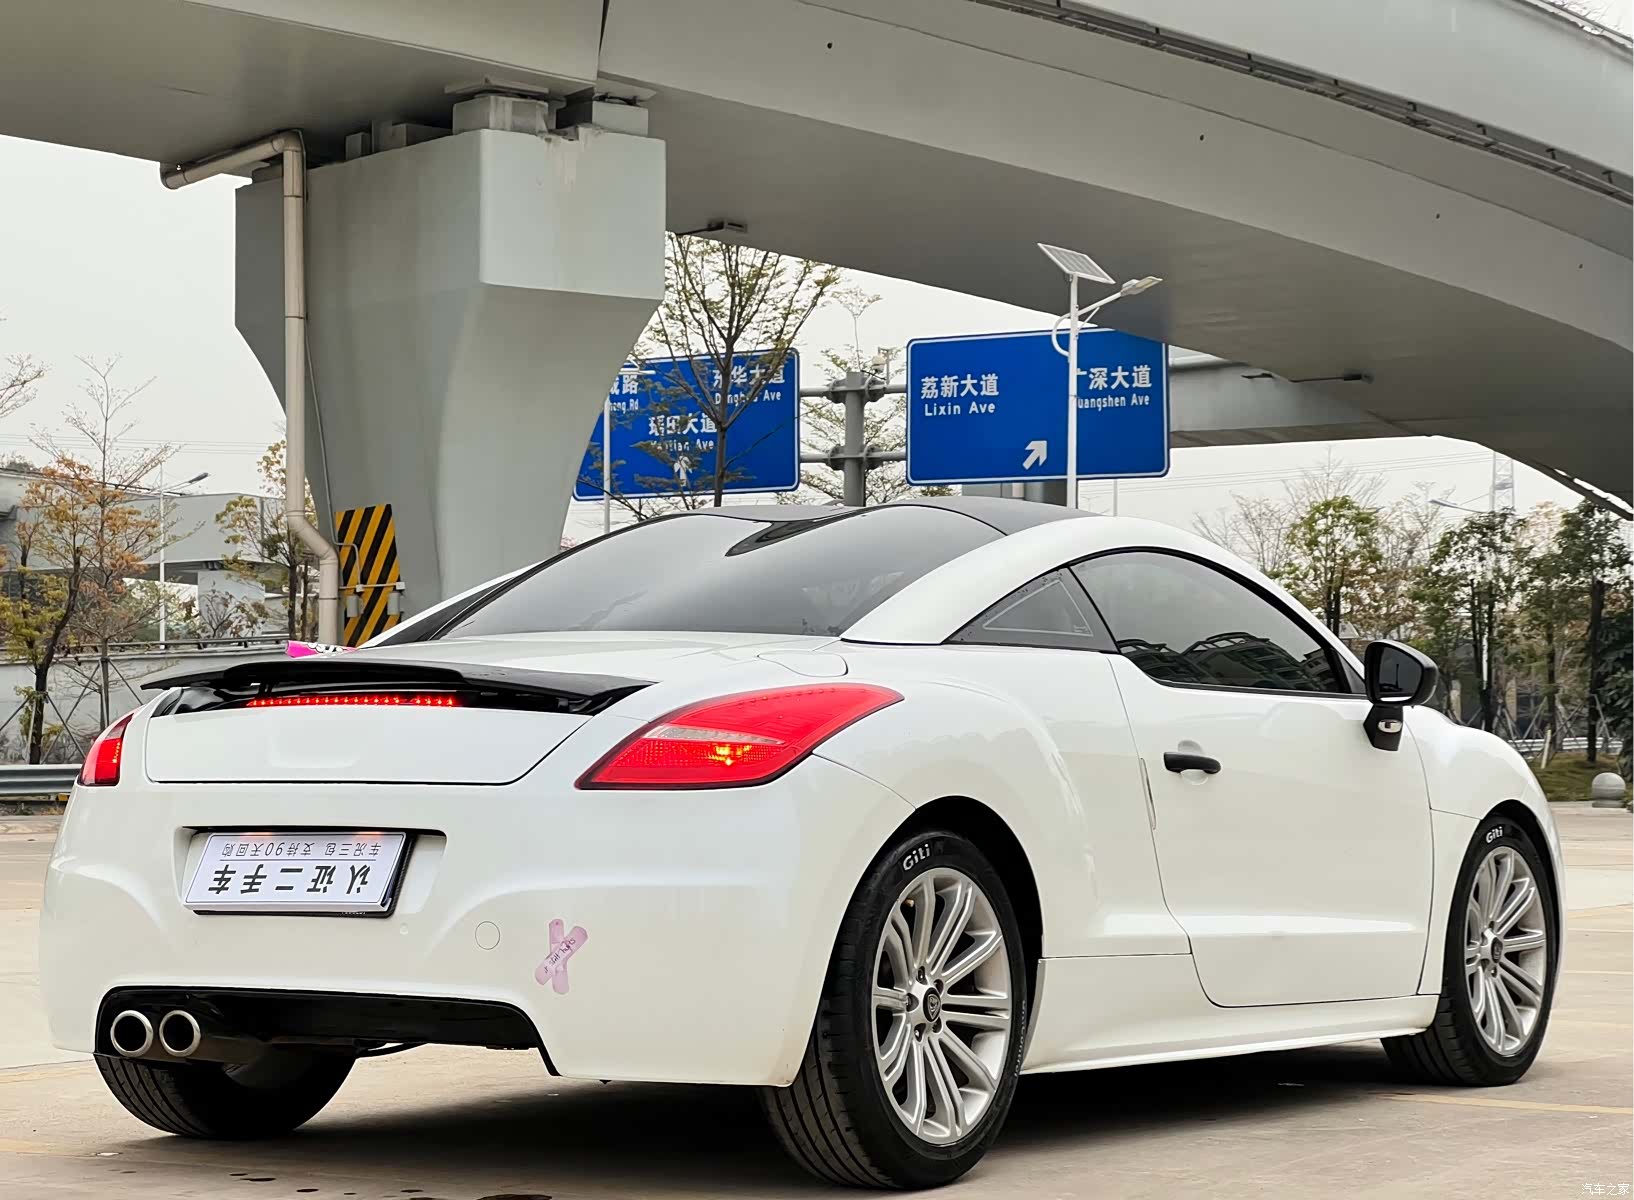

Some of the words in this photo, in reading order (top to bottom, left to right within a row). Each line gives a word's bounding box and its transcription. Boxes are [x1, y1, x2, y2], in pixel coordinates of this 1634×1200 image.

[920, 373, 1000, 399] 荔新大道
[763, 389, 782, 402] Ave
[1077, 394, 1126, 412] uangshen
[1130, 393, 1150, 406] Ave
[924, 402, 961, 417] Lixin
[968, 401, 996, 414] Ave
[696, 438, 715, 451] Ave
[1485, 826, 1503, 844] Giti
[221, 842, 315, 857] 支持90天回购
[324, 842, 382, 857] 车况三包
[902, 843, 931, 871] Giti
[207, 863, 371, 895] 认证二手车
